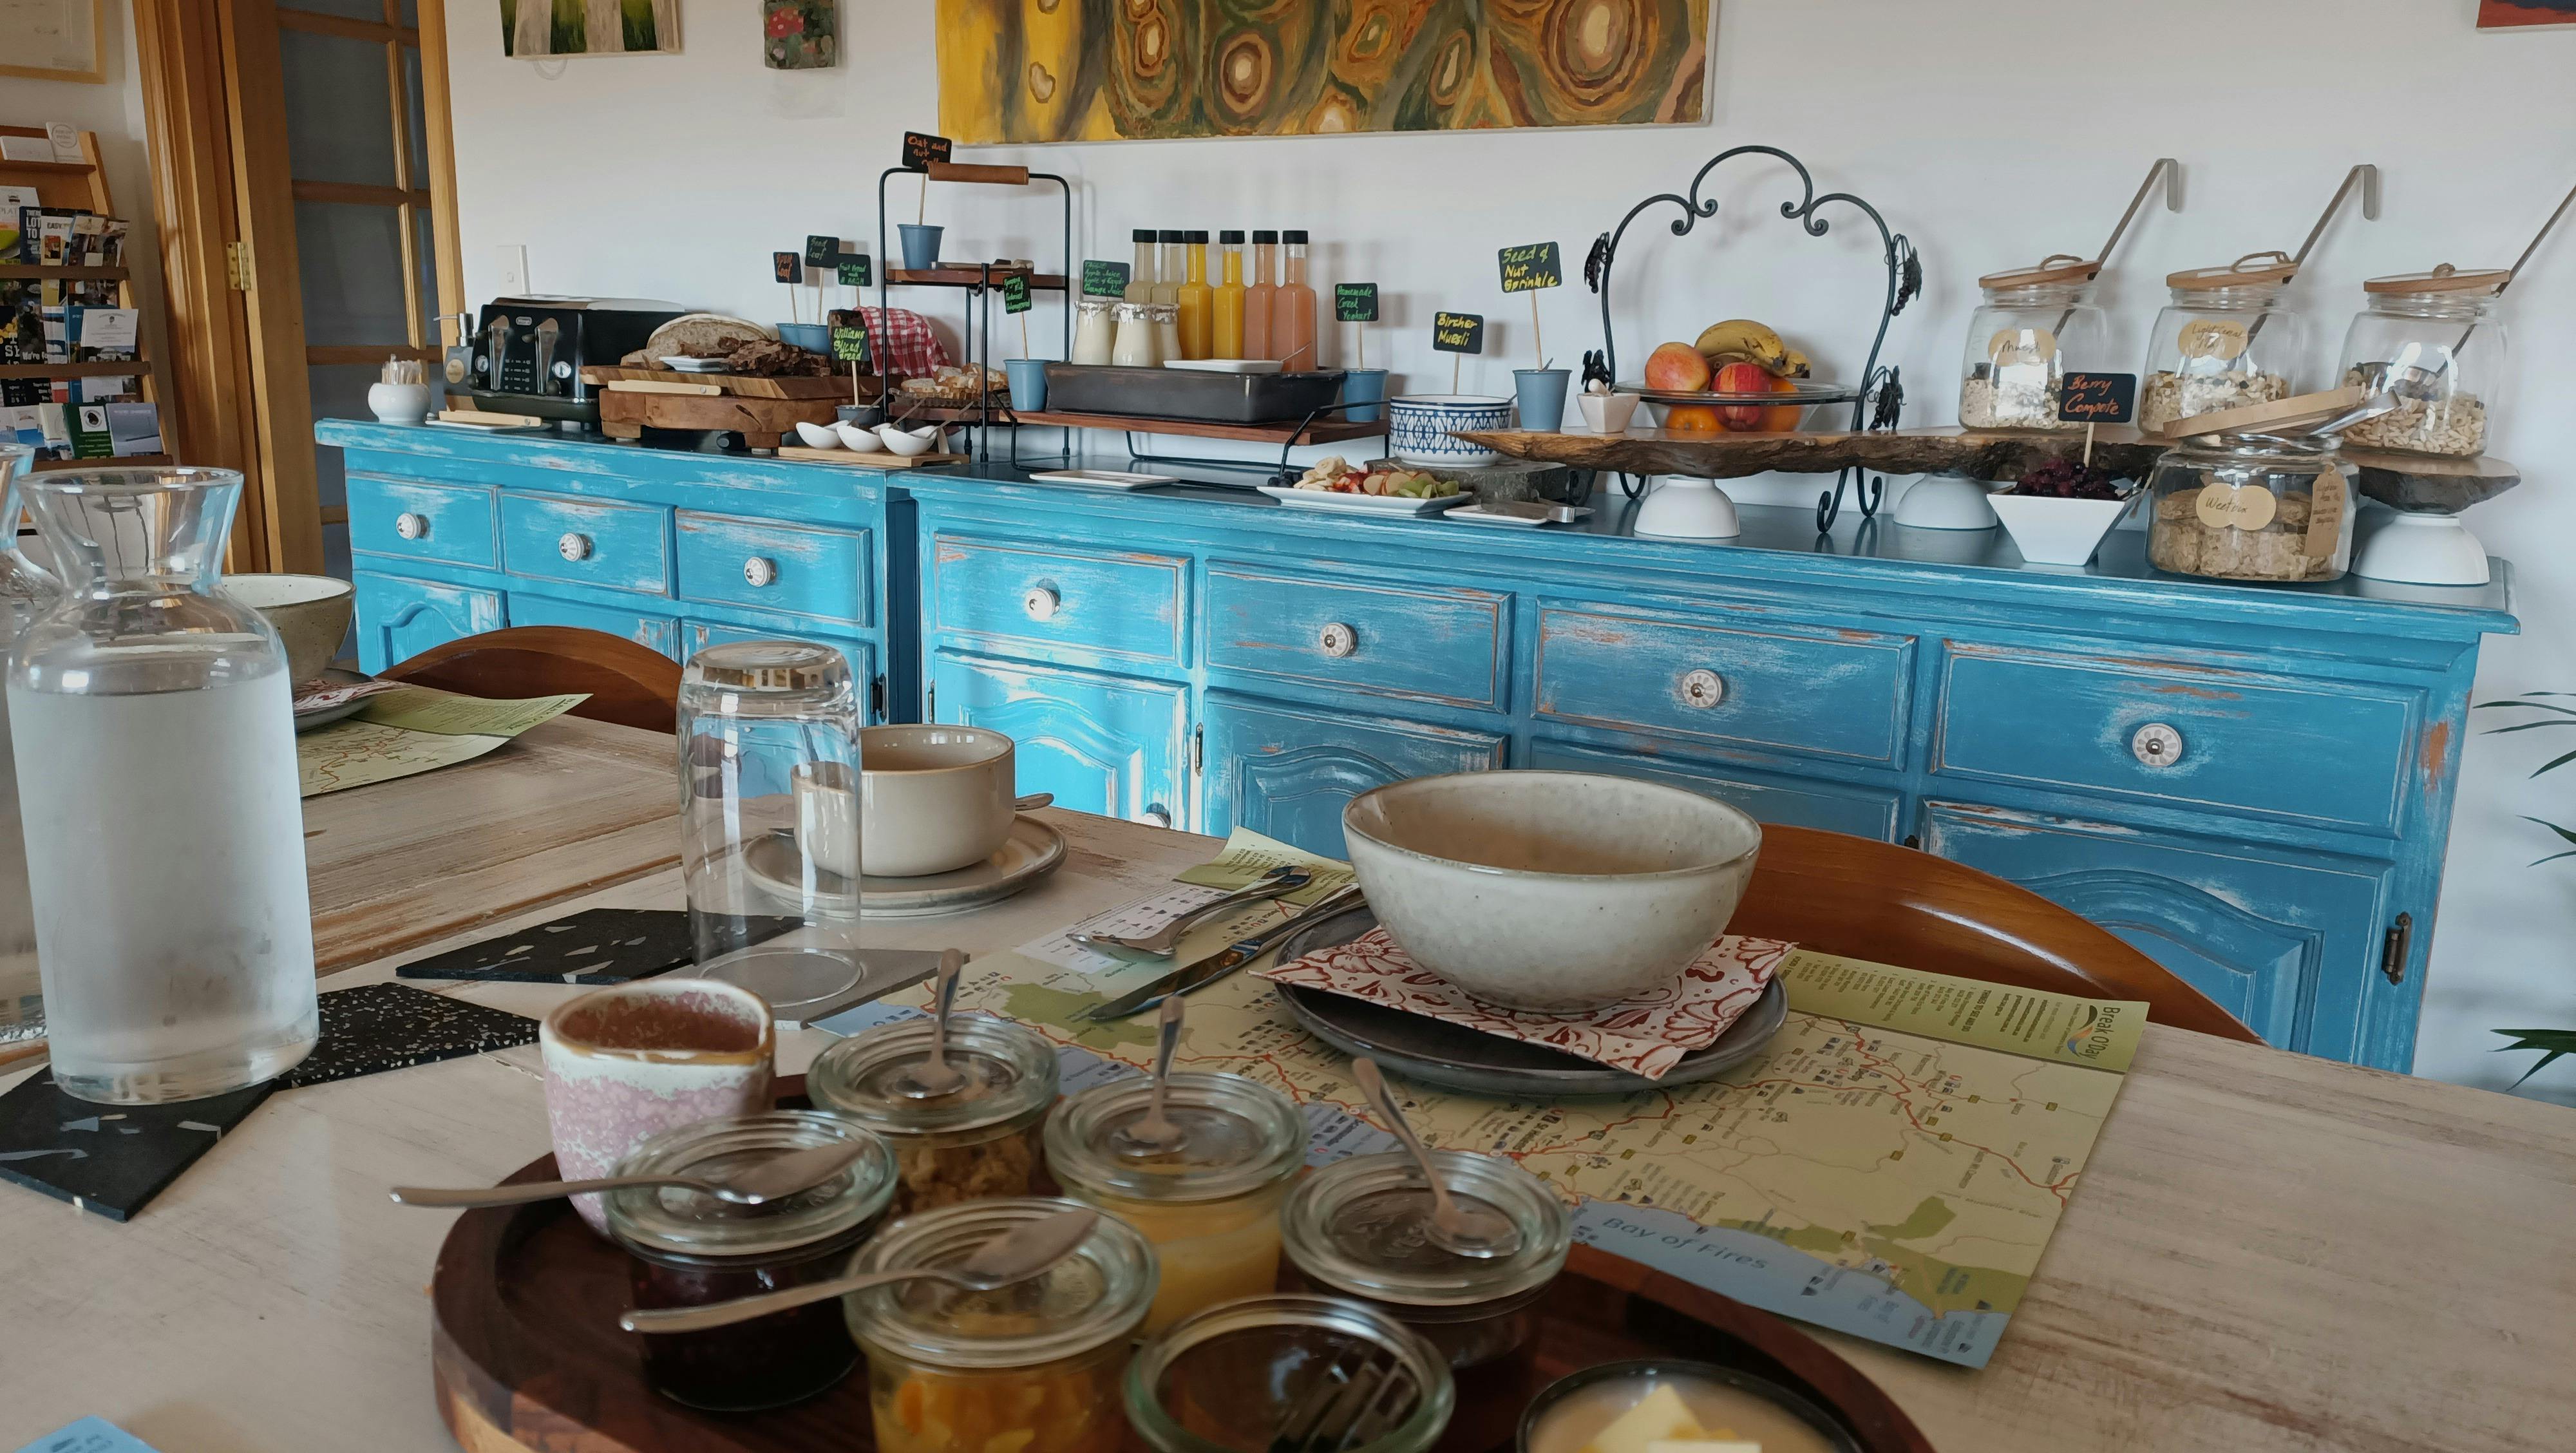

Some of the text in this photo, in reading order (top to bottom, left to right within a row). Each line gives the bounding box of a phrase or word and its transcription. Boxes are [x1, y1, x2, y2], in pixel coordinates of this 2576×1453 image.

[907, 136, 947, 152] Oat and
[1502, 245, 1537, 264] Seed
[1505, 264, 1529, 278] Nut
[1504, 271, 1558, 292] Sprinkle
[1437, 314, 1478, 329] Bircher
[1438, 330, 1470, 347] Muesli
[2068, 374, 2112, 396] Berry
[2065, 392, 2119, 420] Compote
[2083, 1007, 2121, 1060] Break O'Day
[1602, 1218, 1769, 1269] Bay of Fires
